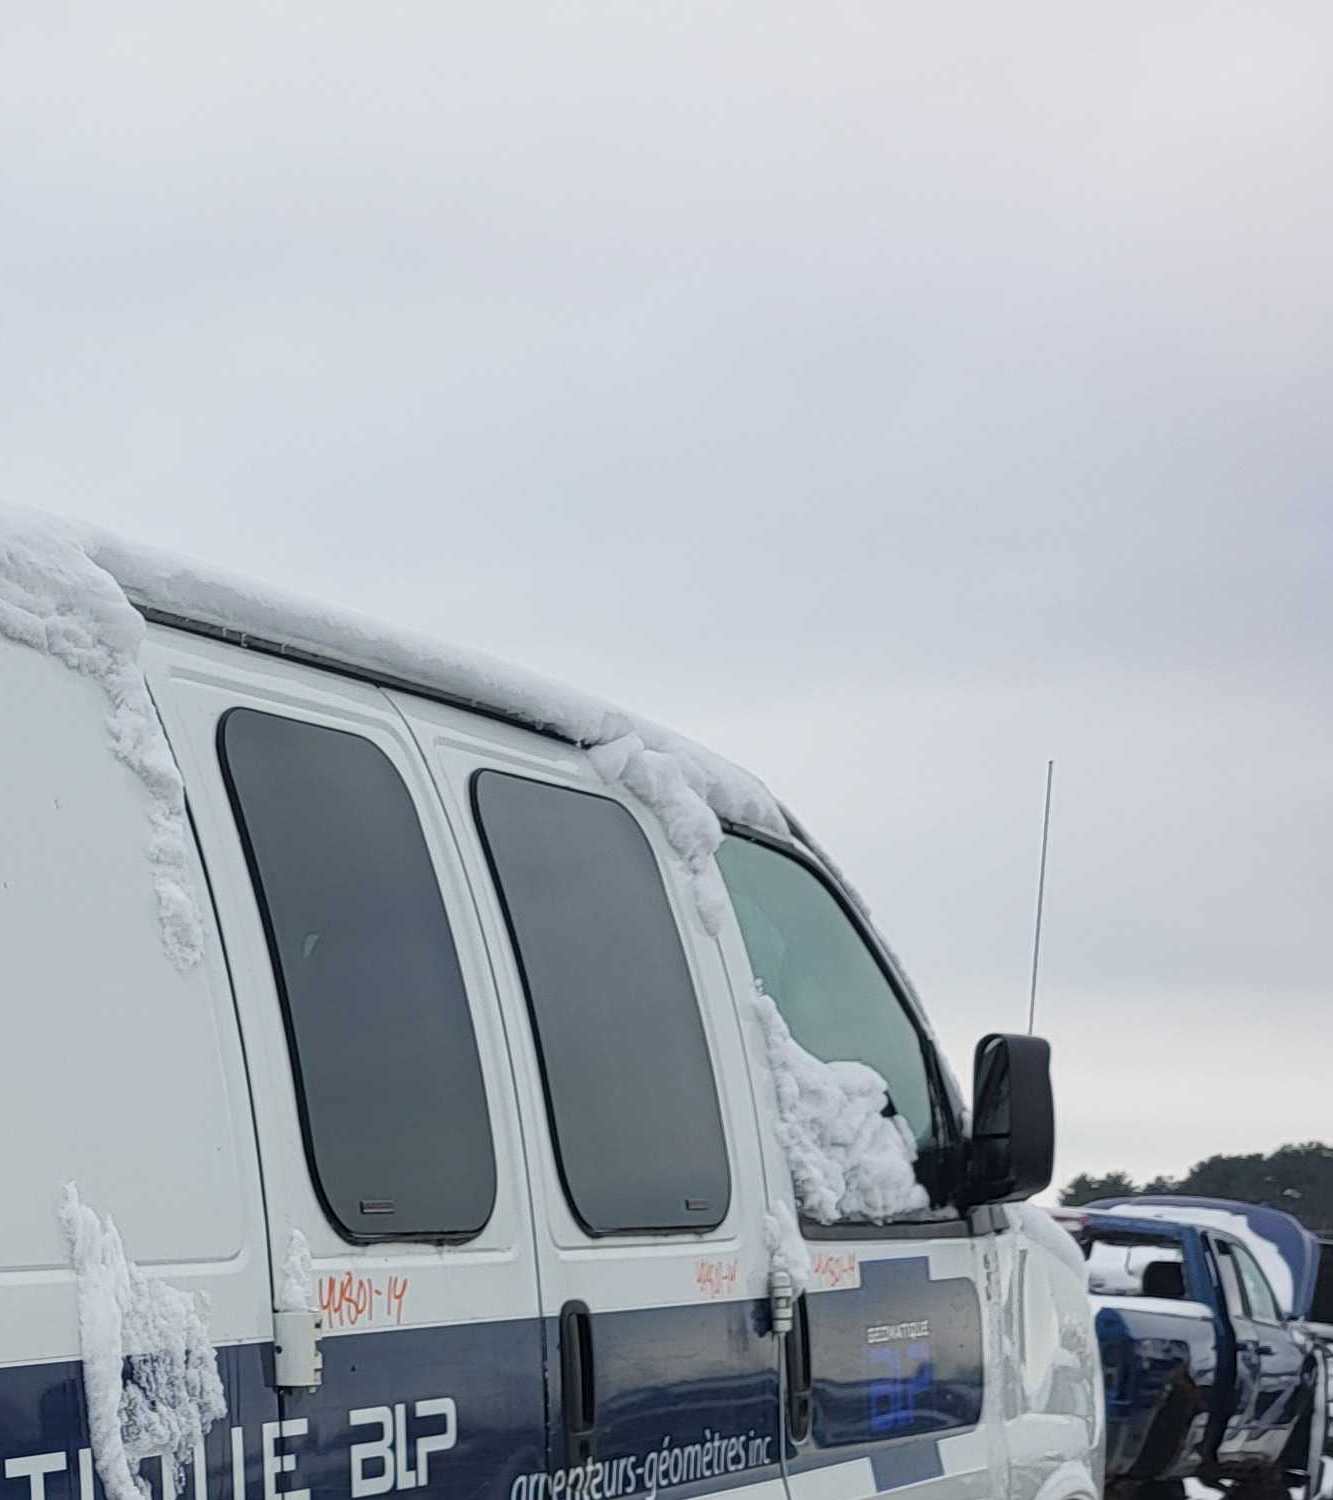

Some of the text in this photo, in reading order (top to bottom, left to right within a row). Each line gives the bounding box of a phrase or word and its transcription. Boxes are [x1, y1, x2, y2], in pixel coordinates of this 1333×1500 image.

[319, 1271, 409, 1328] 44801-14
[349, 1397, 457, 1499] BLP
[748, 1431, 773, 1466] inc
